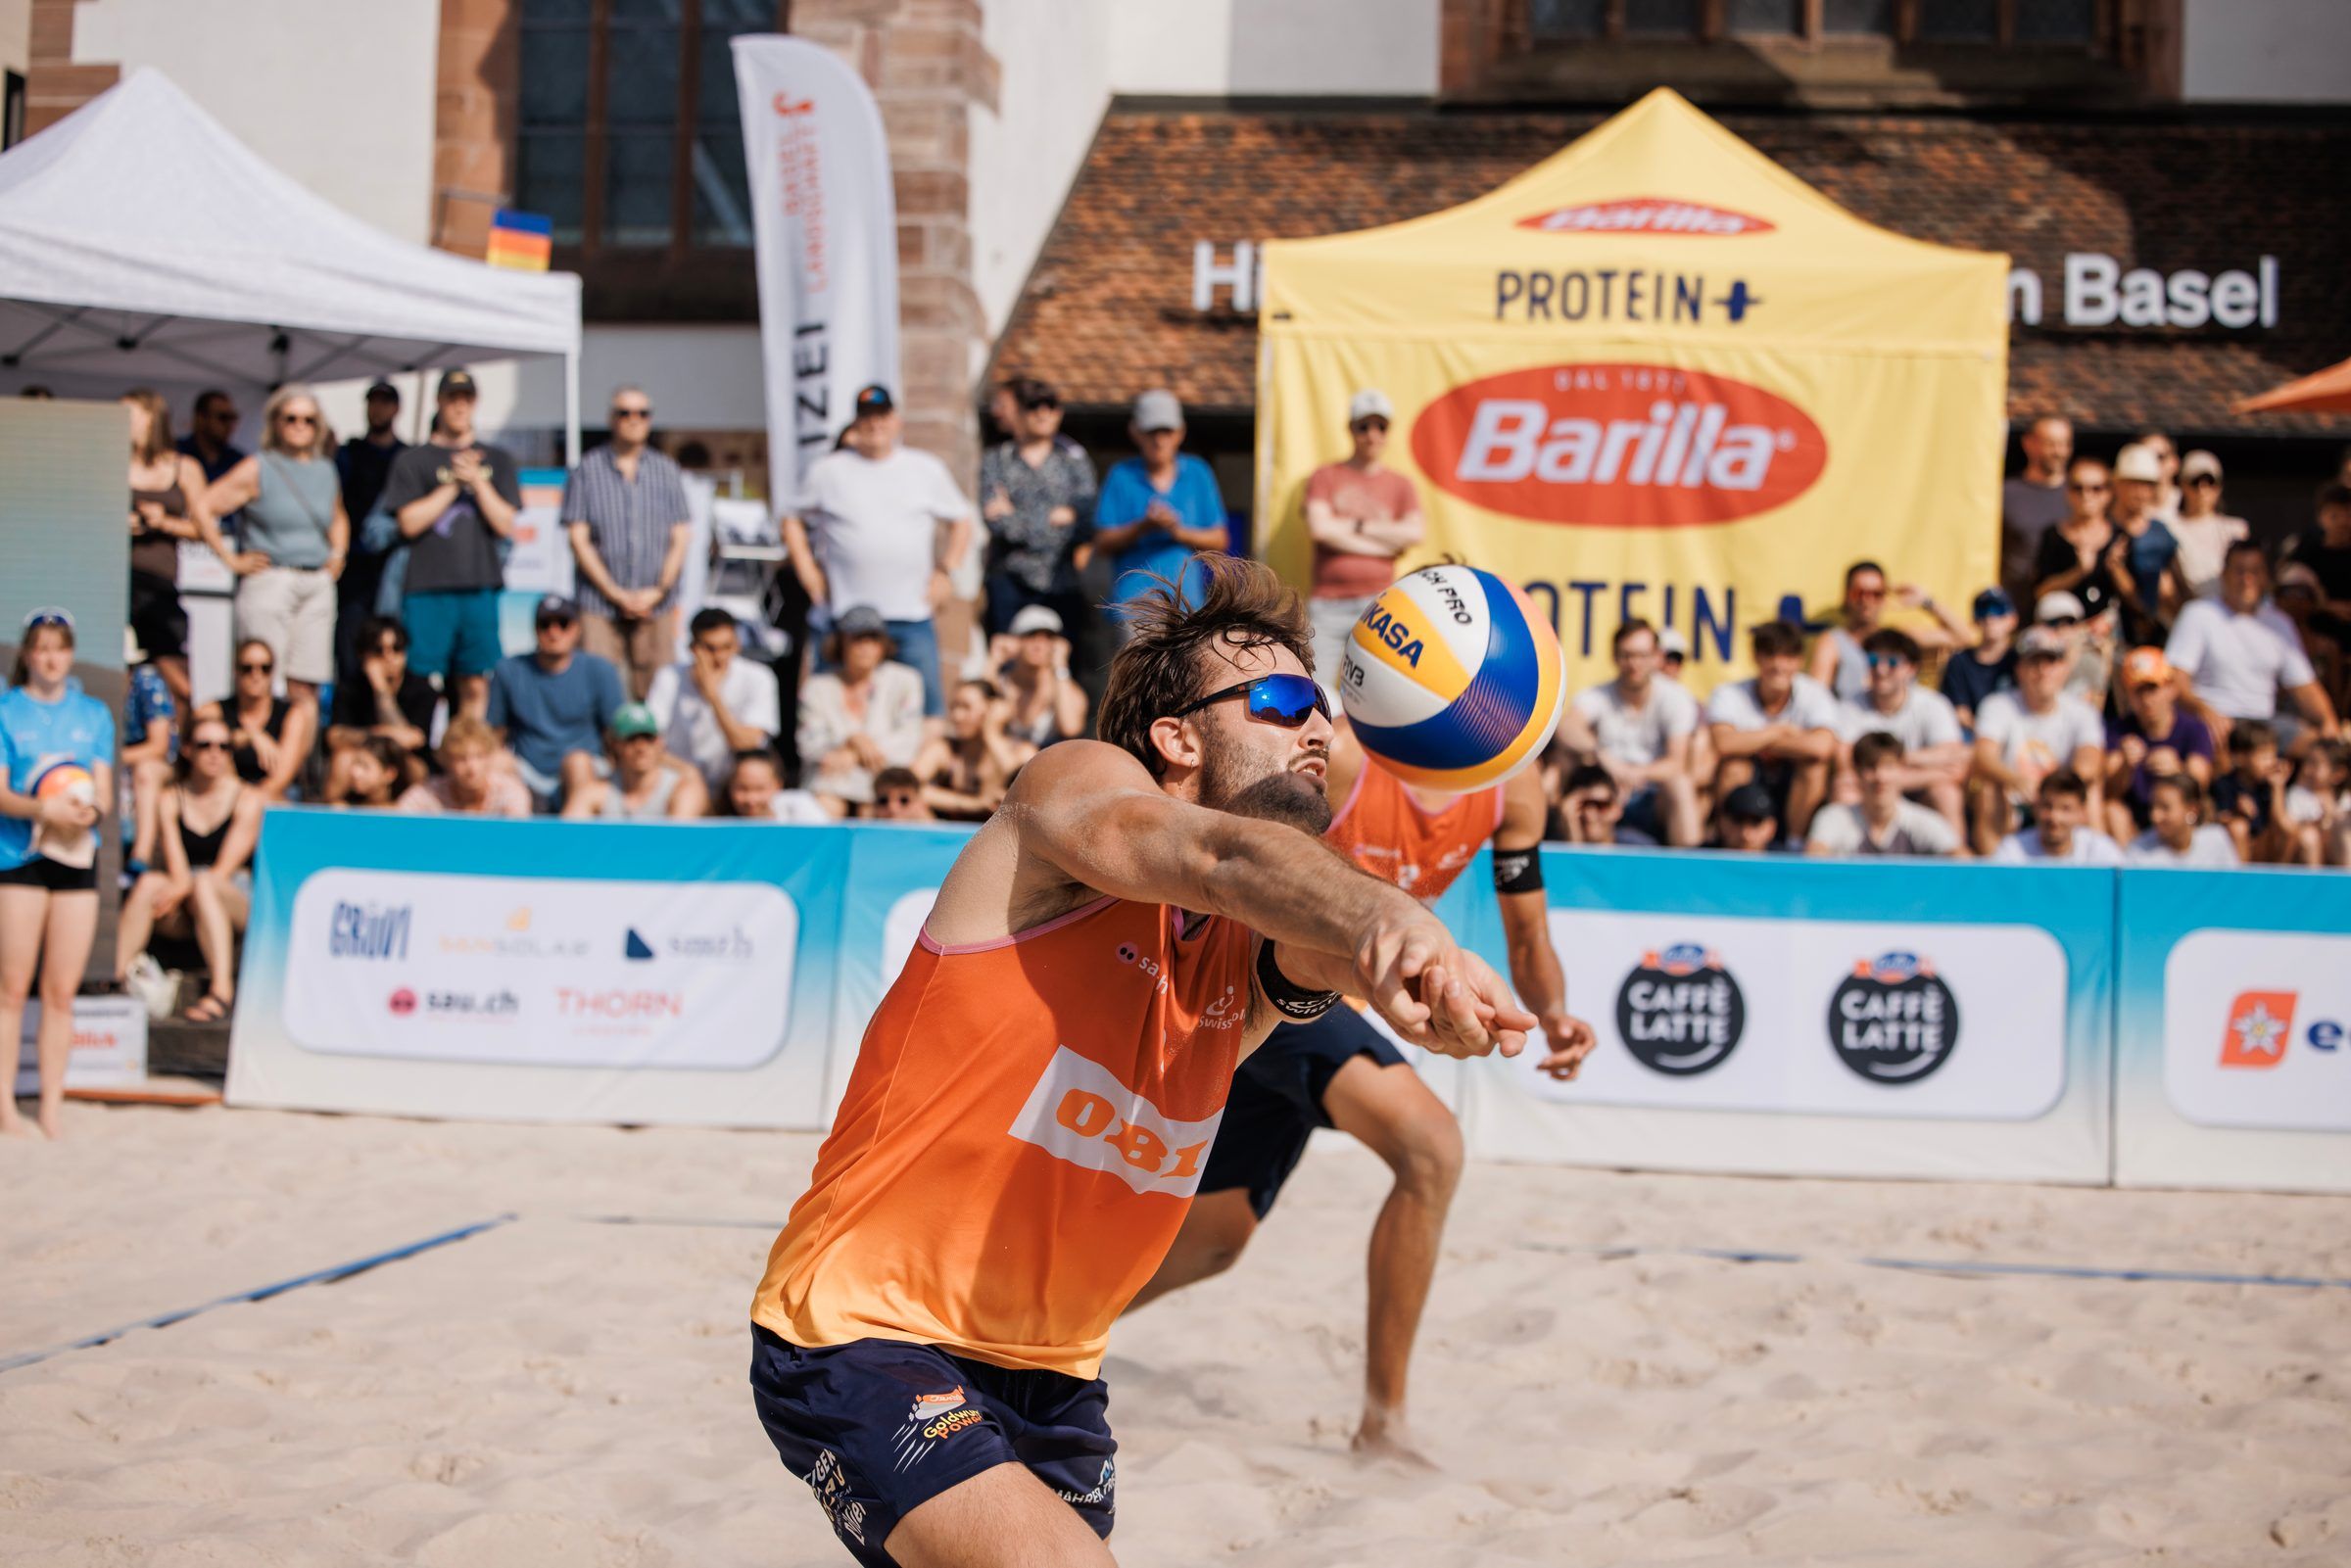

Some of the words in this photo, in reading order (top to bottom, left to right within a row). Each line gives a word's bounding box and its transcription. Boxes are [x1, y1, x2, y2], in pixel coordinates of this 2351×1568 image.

[2063, 252, 2280, 329] Basel
[1437, 587, 1472, 625] PRO
[555, 987, 682, 1019] THORN
[1630, 1013, 1731, 1044] LATTE
[1843, 1022, 1944, 1053] LATTE
[2307, 1020, 2343, 1051] e
